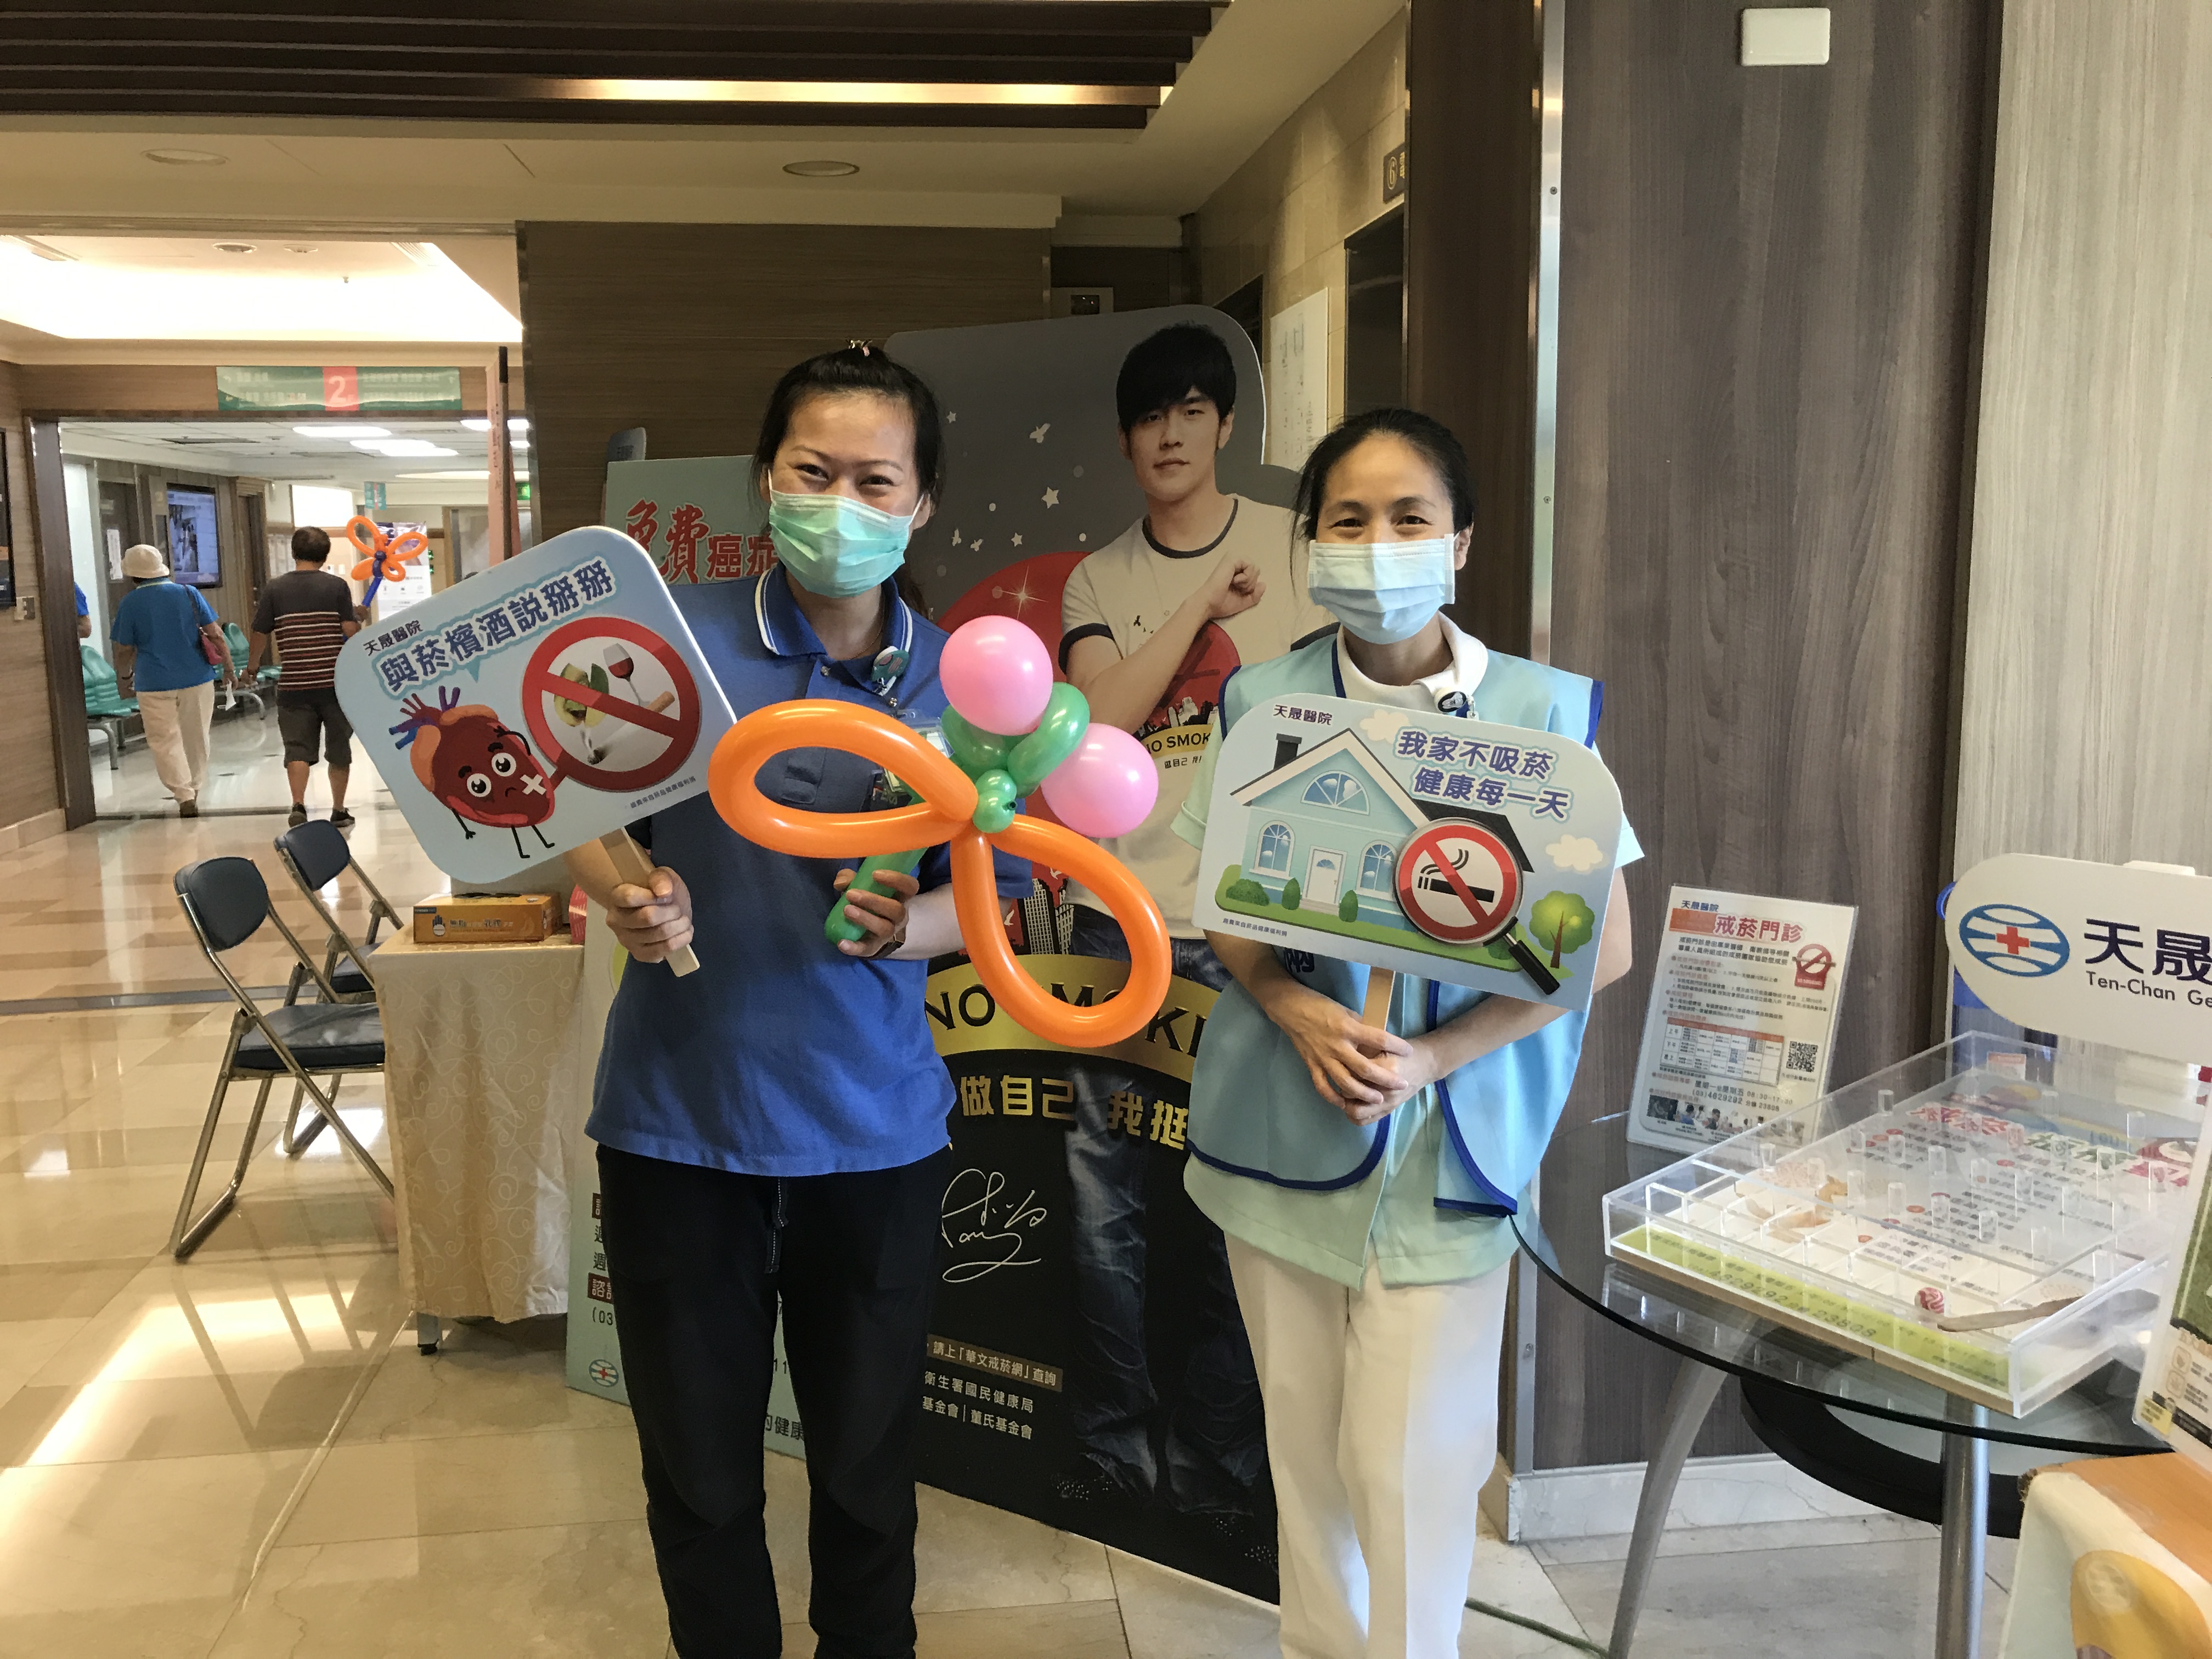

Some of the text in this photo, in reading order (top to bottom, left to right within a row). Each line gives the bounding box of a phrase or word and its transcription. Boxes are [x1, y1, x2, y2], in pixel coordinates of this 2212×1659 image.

[330, 375, 347, 403] 2
[363, 620, 424, 656] 天晟醫院
[1273, 704, 1333, 725] 天晟醫院
[1398, 731, 1553, 780] 我家不吸菸
[1413, 767, 1568, 819] 健康每一天
[1714, 915, 1803, 944] 戒菸門診
[2083, 918, 2212, 986] 天晟
[2086, 970, 2175, 1001] Ten-Chan
[960, 1074, 1189, 1150] 做自己 我挺
[592, 1306, 613, 1325] (03
[922, 1396, 958, 1418] 基金會
[924, 1370, 1033, 1413] 衛生署國民健康局
